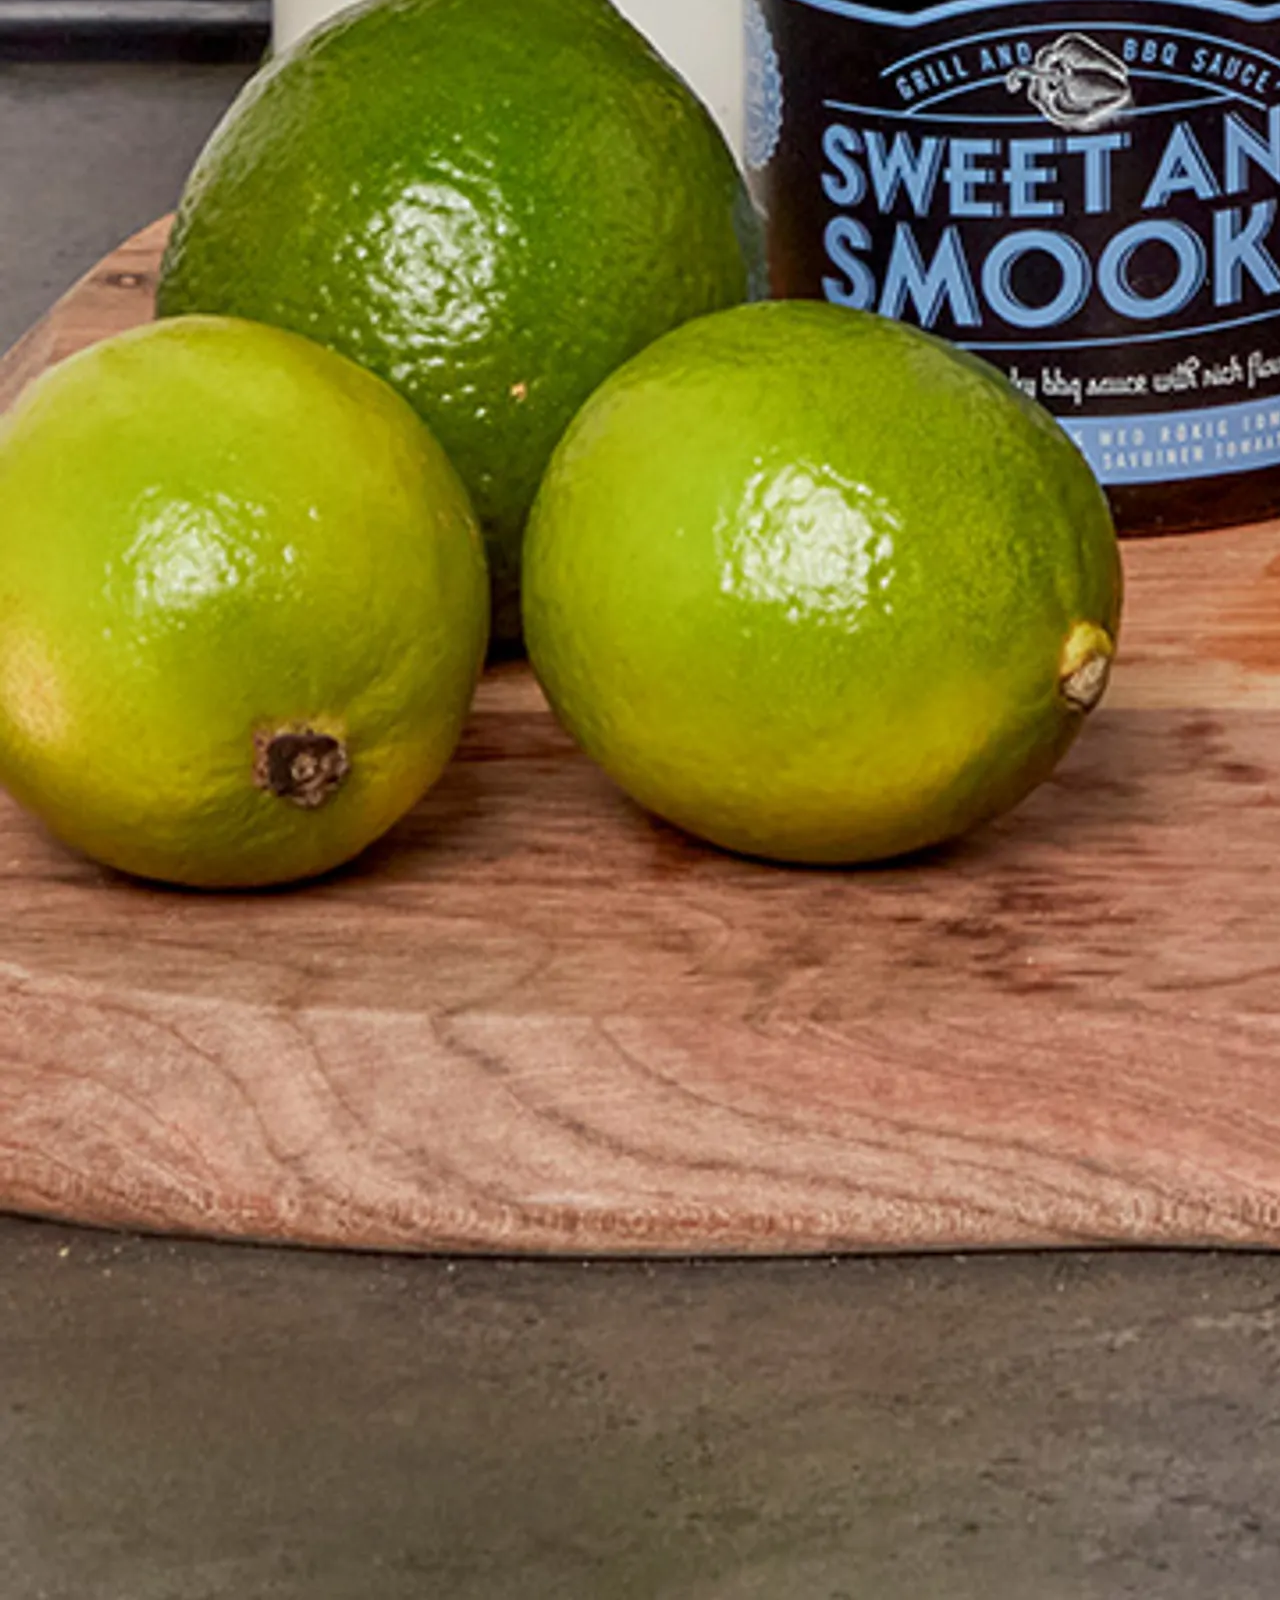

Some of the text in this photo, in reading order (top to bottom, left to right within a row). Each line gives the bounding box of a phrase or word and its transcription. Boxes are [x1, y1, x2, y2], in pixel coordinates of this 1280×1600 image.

[896, 38, 1271, 101] GRILL AND BBQ SAUCE
[821, 122, 1131, 217] SWEET
[1042, 367, 1081, 404] bbq
[1153, 355, 1199, 393] with
[1202, 360, 1244, 387] rich
